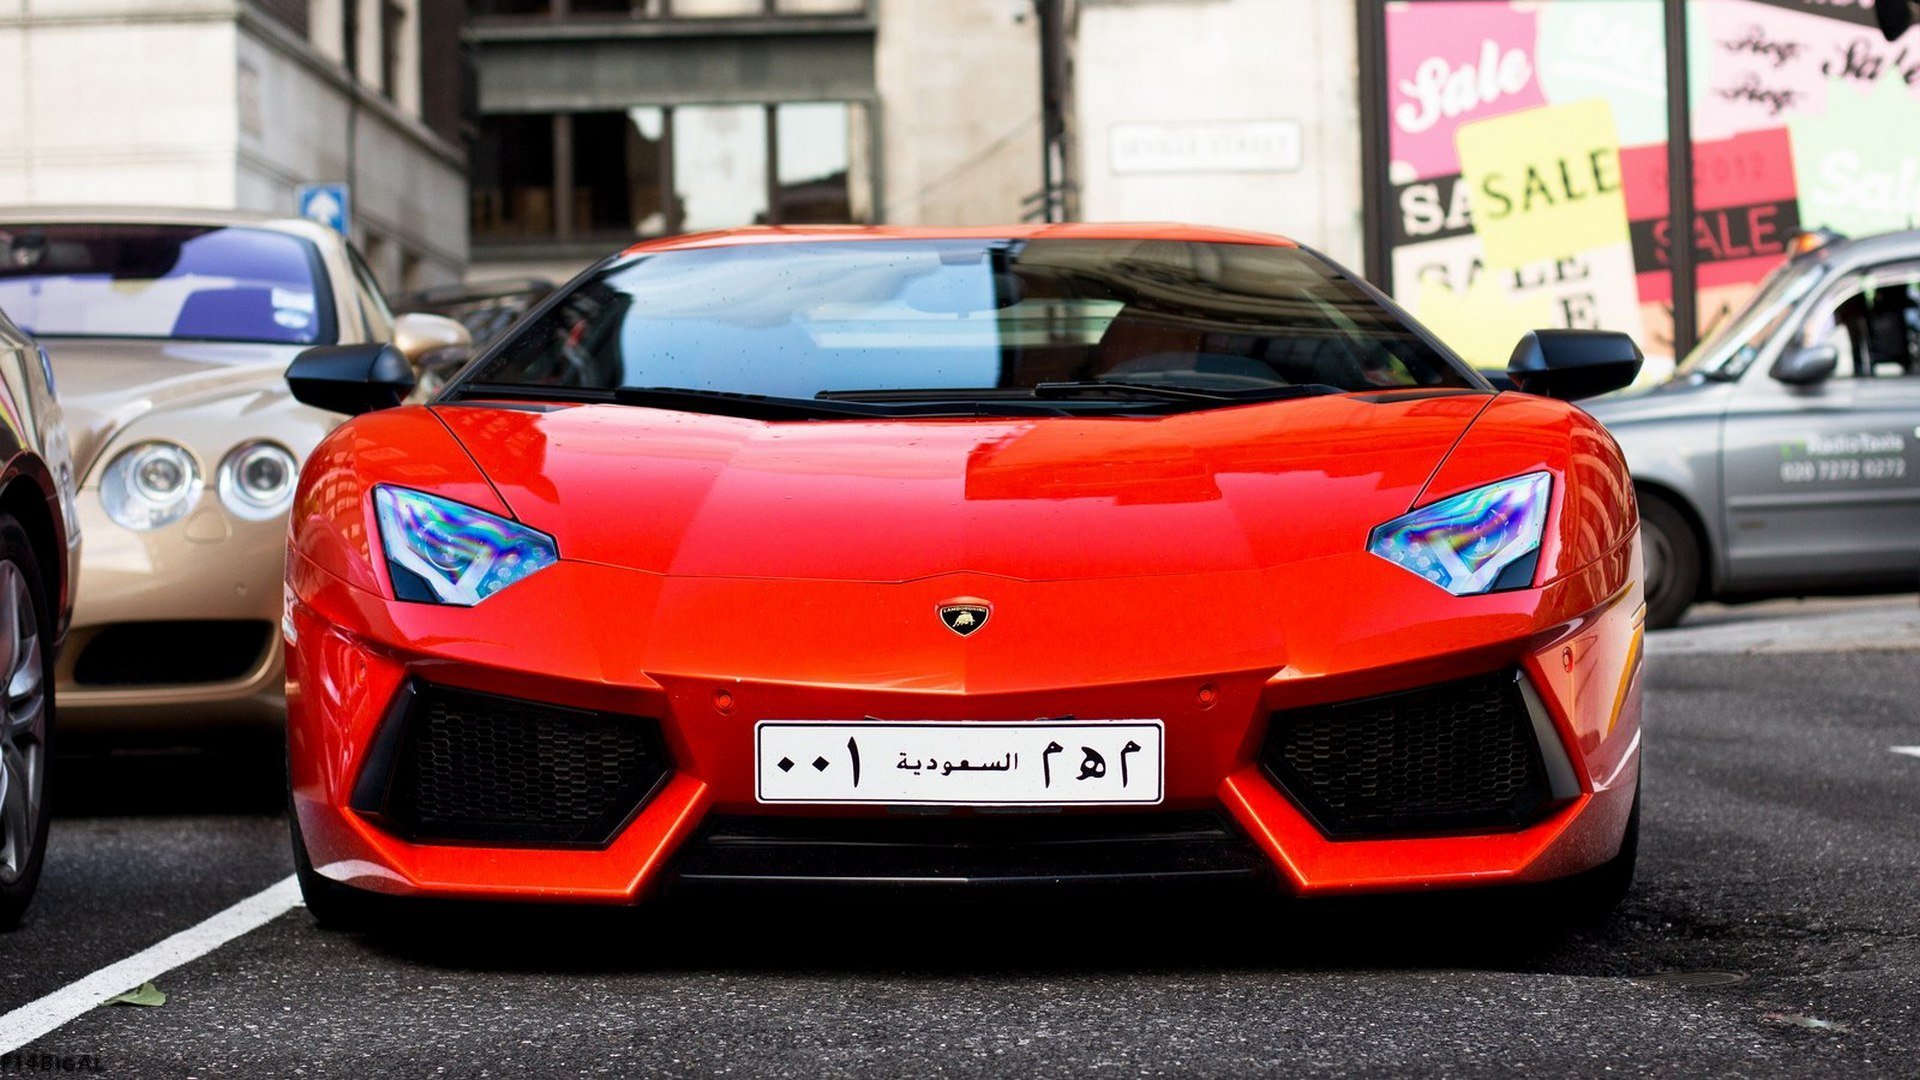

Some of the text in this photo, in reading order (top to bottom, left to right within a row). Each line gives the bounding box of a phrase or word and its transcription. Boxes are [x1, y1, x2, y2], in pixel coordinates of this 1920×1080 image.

[1395, 39, 1531, 133] Sale
[1483, 149, 1619, 219] SALE
[1812, 149, 1920, 213] Sal
[1653, 205, 1781, 260] SALE
[896, 751, 1018, 777] السعودية
